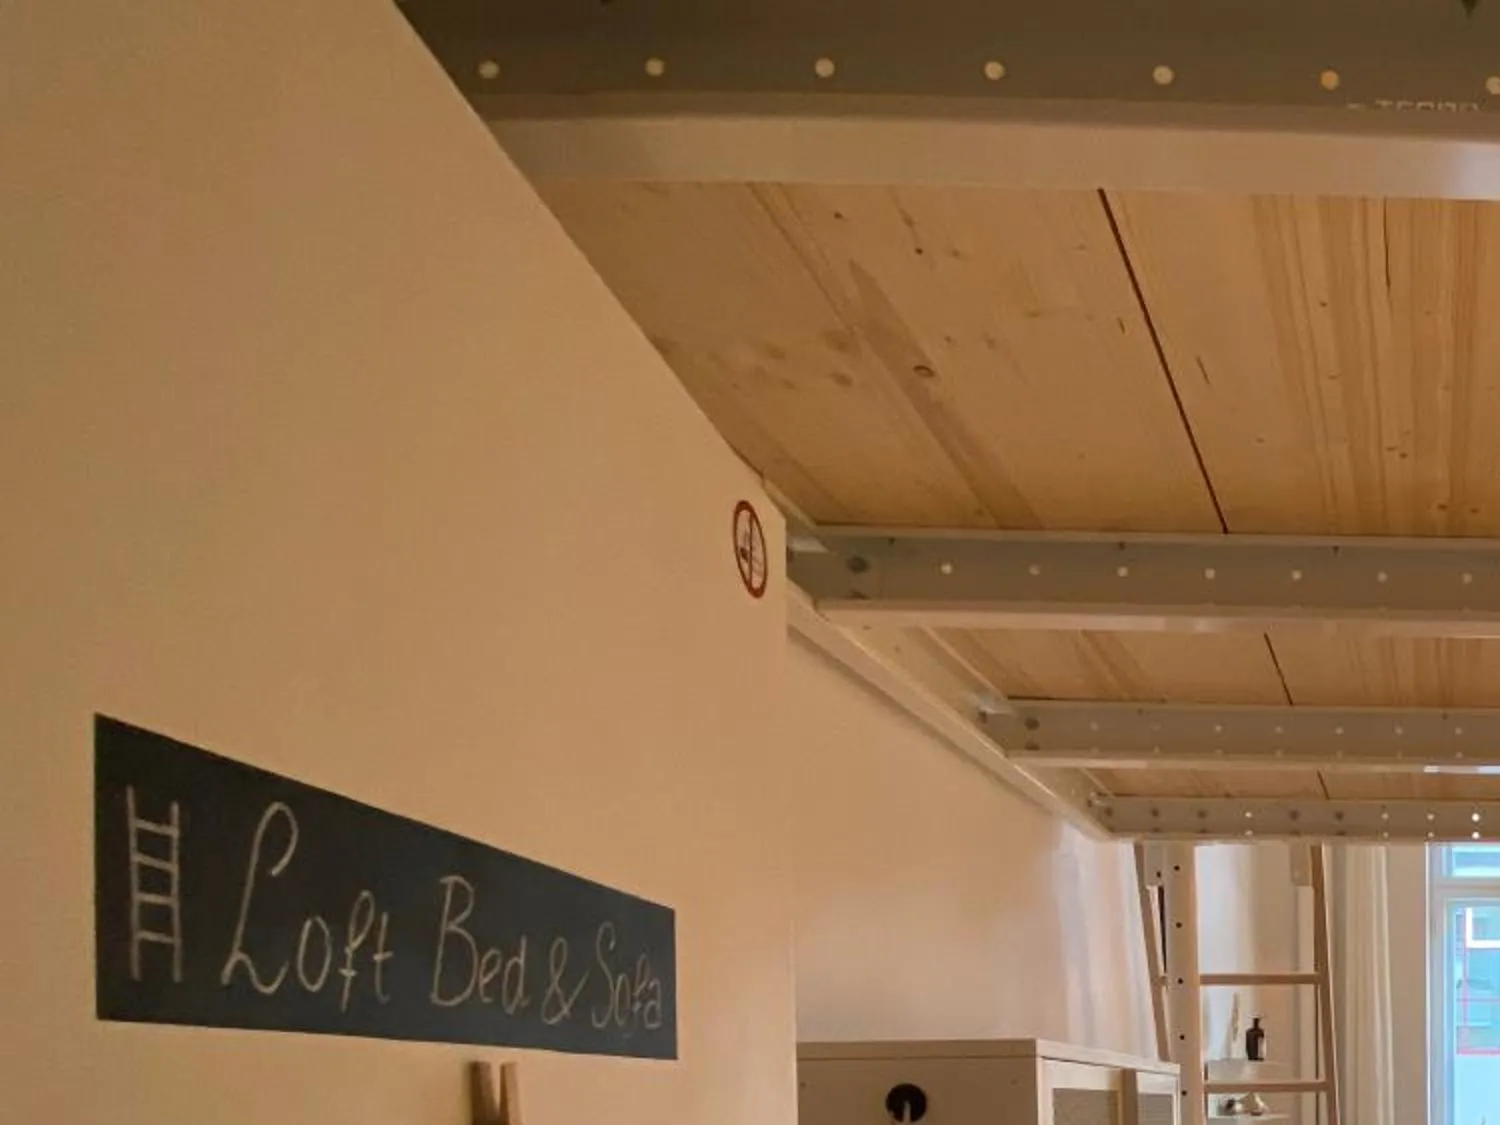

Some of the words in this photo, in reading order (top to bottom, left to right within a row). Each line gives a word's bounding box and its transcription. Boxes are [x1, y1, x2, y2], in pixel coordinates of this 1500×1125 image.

[220, 801, 394, 1012] Loft
[430, 874, 527, 1015] Bed
[540, 936, 589, 1024] &
[590, 920, 662, 1032] Sofa
